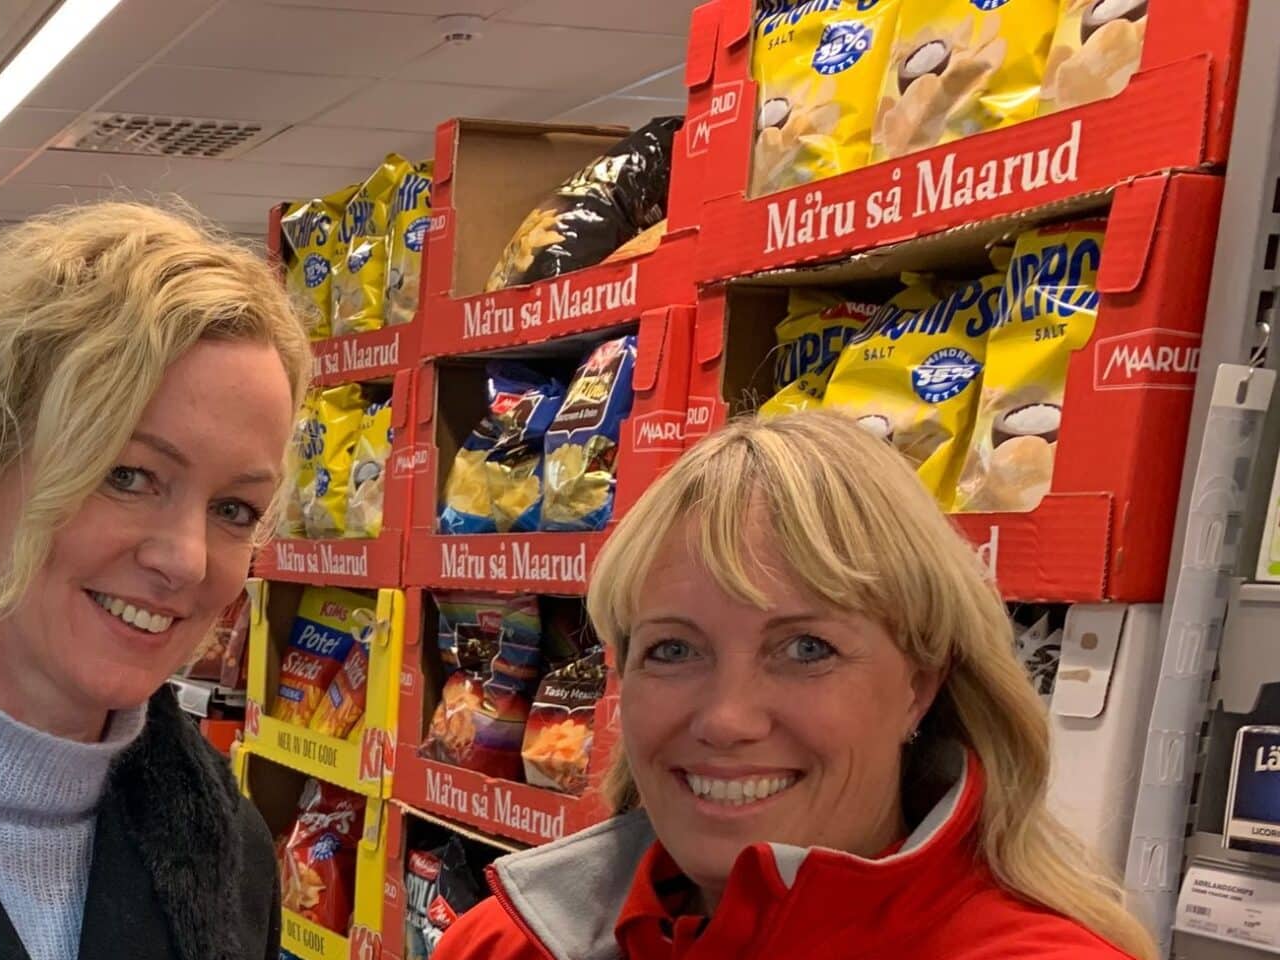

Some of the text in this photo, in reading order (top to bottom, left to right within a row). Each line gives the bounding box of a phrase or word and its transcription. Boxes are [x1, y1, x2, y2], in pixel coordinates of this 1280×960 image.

[767, 29, 795, 50] SALT
[912, 119, 1082, 218] Maarud
[547, 263, 638, 323] Maarud
[1034, 324, 1067, 342] SALT
[342, 332, 400, 372] Maarud
[863, 346, 895, 361] SALT
[926, 347, 974, 366] MINDRE
[925, 384, 955, 403] FETT
[320, 543, 368, 577] Maarud
[511, 543, 586, 583] Maarud
[297, 625, 341, 656] Potet
[282, 651, 322, 681] Sticks
[544, 686, 570, 699] Tasty
[493, 786, 566, 841] Maarud
